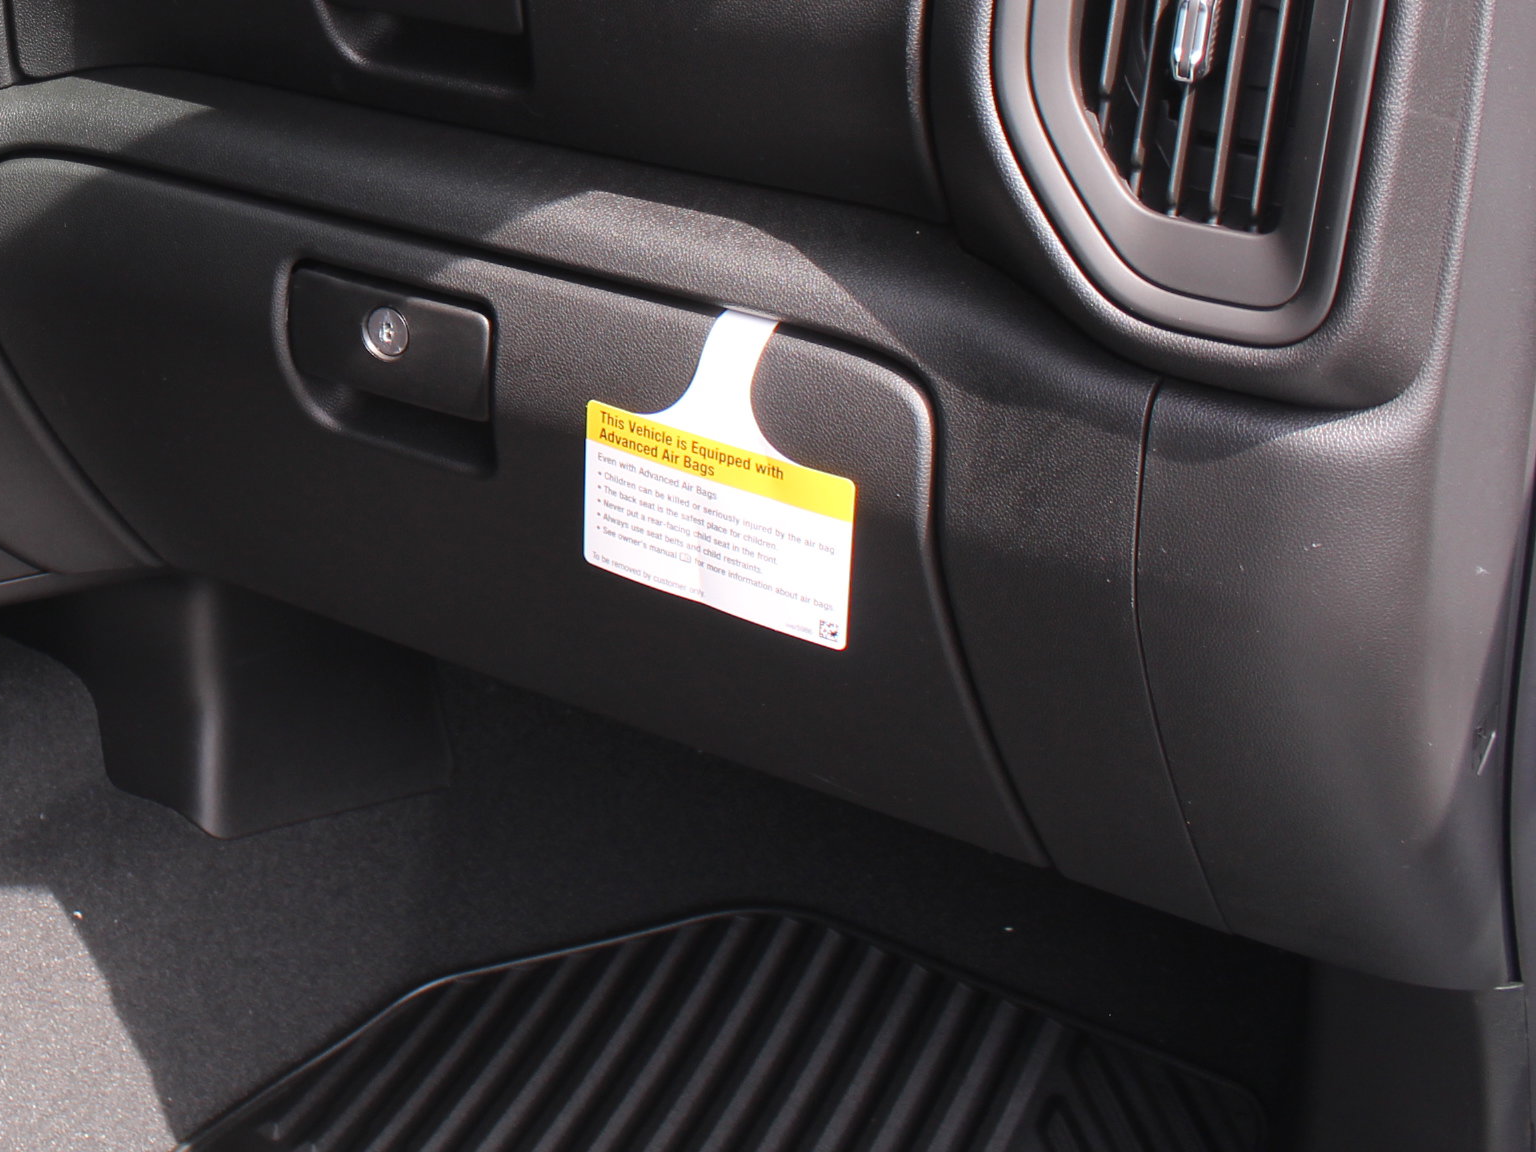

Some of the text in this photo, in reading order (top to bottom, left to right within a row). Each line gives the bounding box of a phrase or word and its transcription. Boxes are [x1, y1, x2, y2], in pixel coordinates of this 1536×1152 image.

[600, 410, 784, 480] This Vehicle is Equipped with
[600, 428, 715, 476] Advanced Air Bags
[597, 452, 717, 500] Even with Advanced Air Bags
[603, 499, 624, 513] Never
[626, 508, 638, 519] put
[647, 516, 691, 537] rear-facing
[693, 530, 712, 543] child
[714, 537, 730, 549] seat
[732, 543, 740, 552] in
[742, 547, 755, 558] the
[603, 513, 629, 529] Always
[631, 525, 644, 535] use
[647, 530, 663, 540] seat
[664, 535, 684, 547] belts
[686, 543, 701, 553] and
[703, 548, 721, 560] child
[604, 485, 617, 497] The
[619, 491, 637, 504] back
[639, 499, 655, 510] seat
[666, 507, 678, 517] the
[681, 512, 704, 526] safest
[706, 521, 727, 535] place
[729, 528, 742, 539] for
[604, 471, 835, 555] Children can be killed or seriously injured by the air bag
[592, 550, 600, 560] To
[601, 554, 610, 565] be
[611, 560, 641, 576] removed
[643, 571, 651, 581] by
[653, 575, 686, 590] customer
[603, 526, 616, 538] See
[618, 534, 647, 549] owner's
[649, 544, 677, 558] manual
[694, 557, 704, 567] for
[707, 563, 726, 576] more
[728, 569, 773, 591] information
[775, 586, 798, 600] about
[800, 594, 811, 604] air
